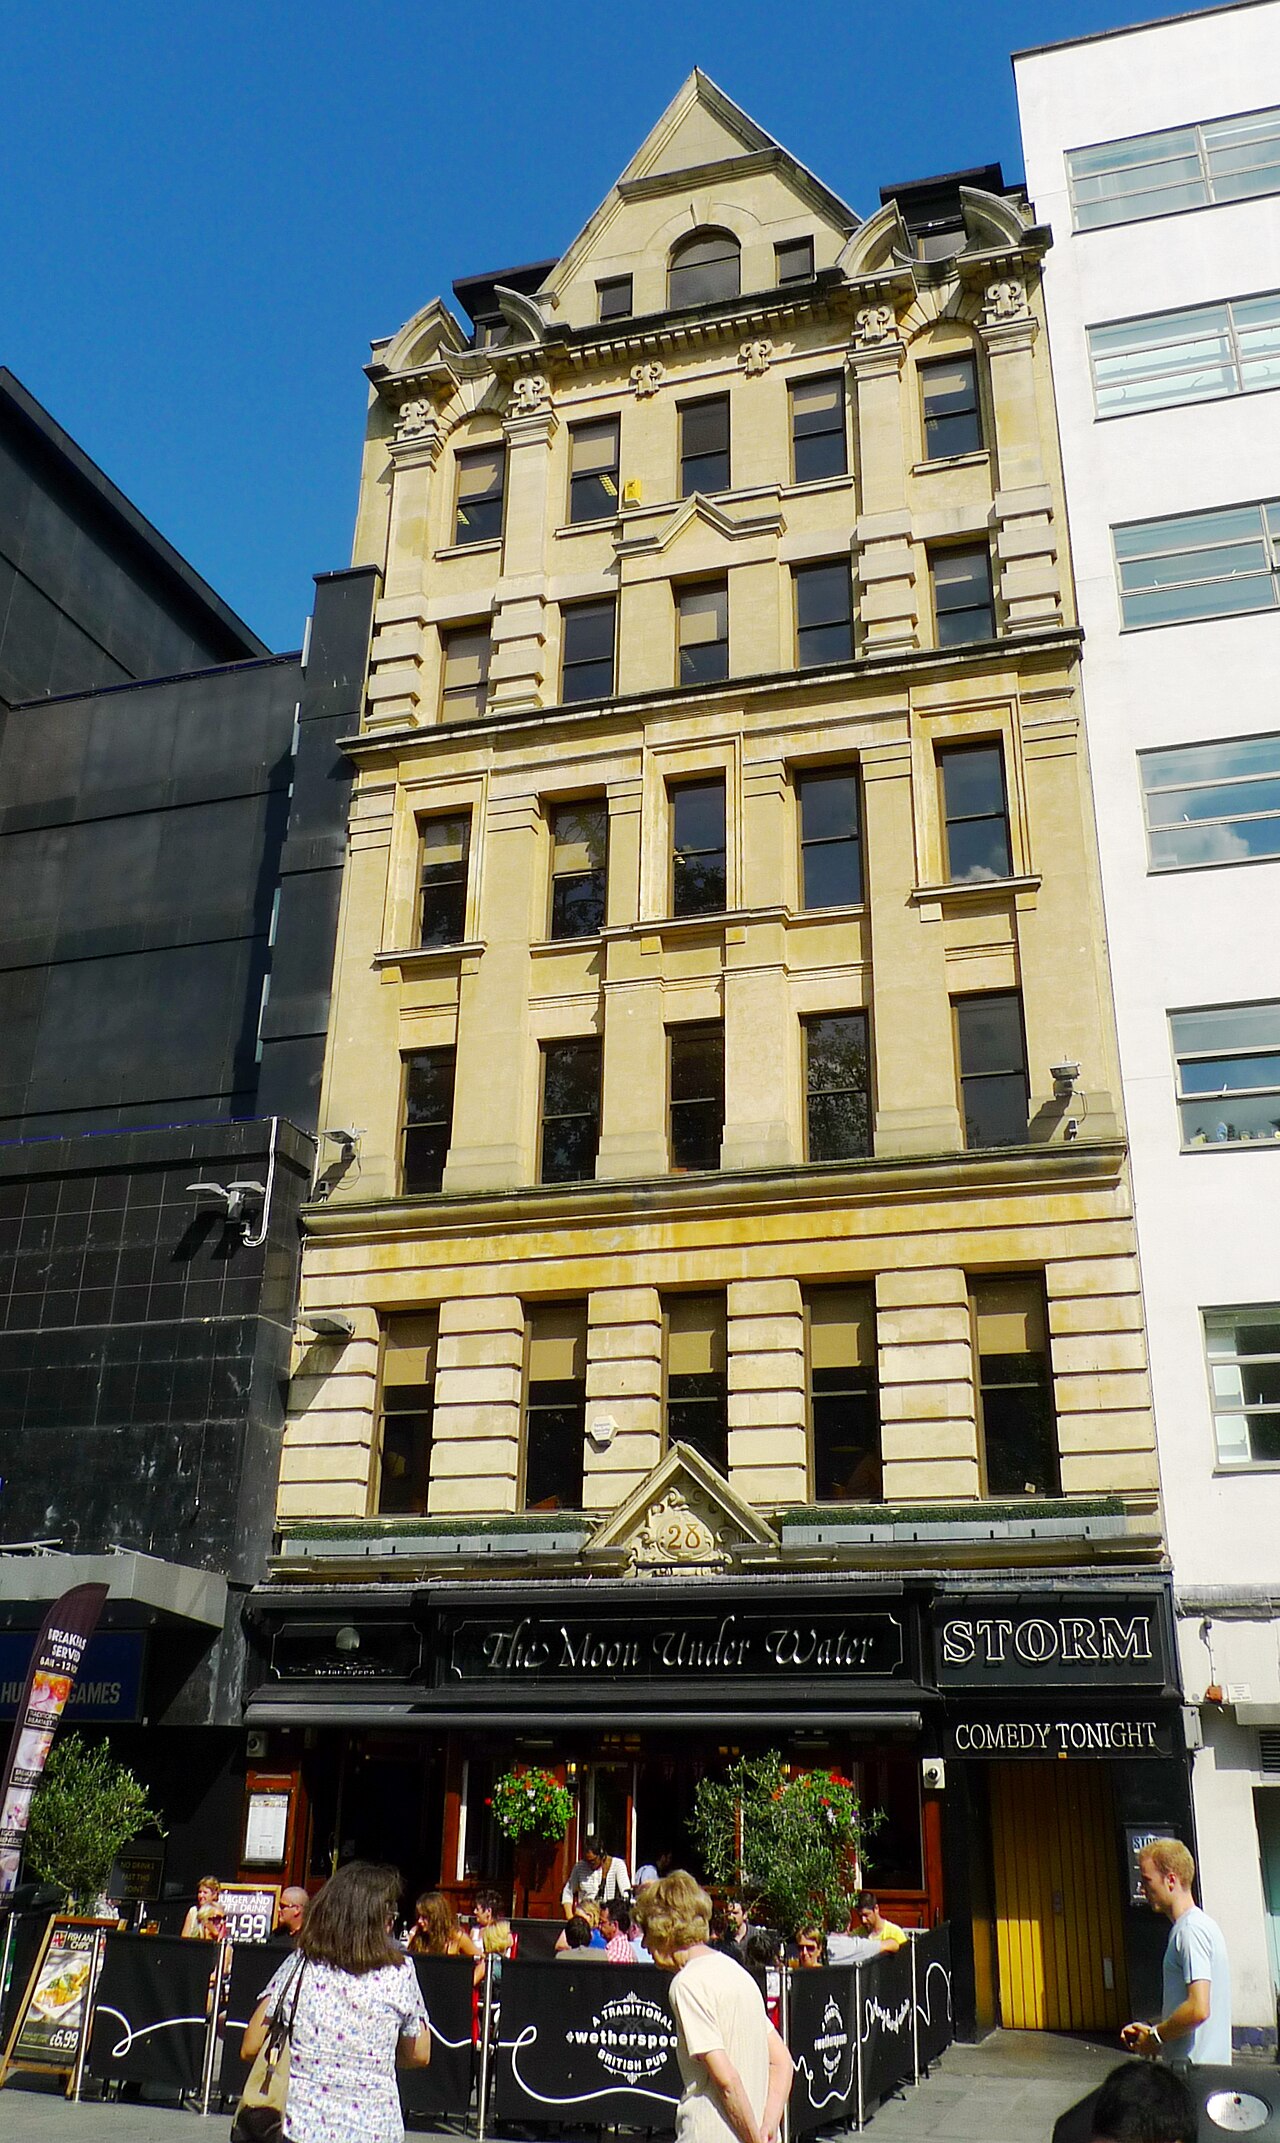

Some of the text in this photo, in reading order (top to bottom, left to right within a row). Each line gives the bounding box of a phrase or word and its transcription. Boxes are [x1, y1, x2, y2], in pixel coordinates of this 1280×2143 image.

[668, 1524, 701, 1549] 28
[484, 1615, 873, 1668] The Moon Under Water
[943, 1617, 1152, 1662] STORM
[956, 1722, 1157, 1750] COMEDY TONIGHT
[240, 1903, 267, 1913] DRINK
[249, 1896, 271, 1905] AND
[592, 2004, 673, 2032] A TRADITIONAL
[574, 2029, 678, 2050] wetherspoo
[597, 2048, 668, 2071] BRITISH PUB
